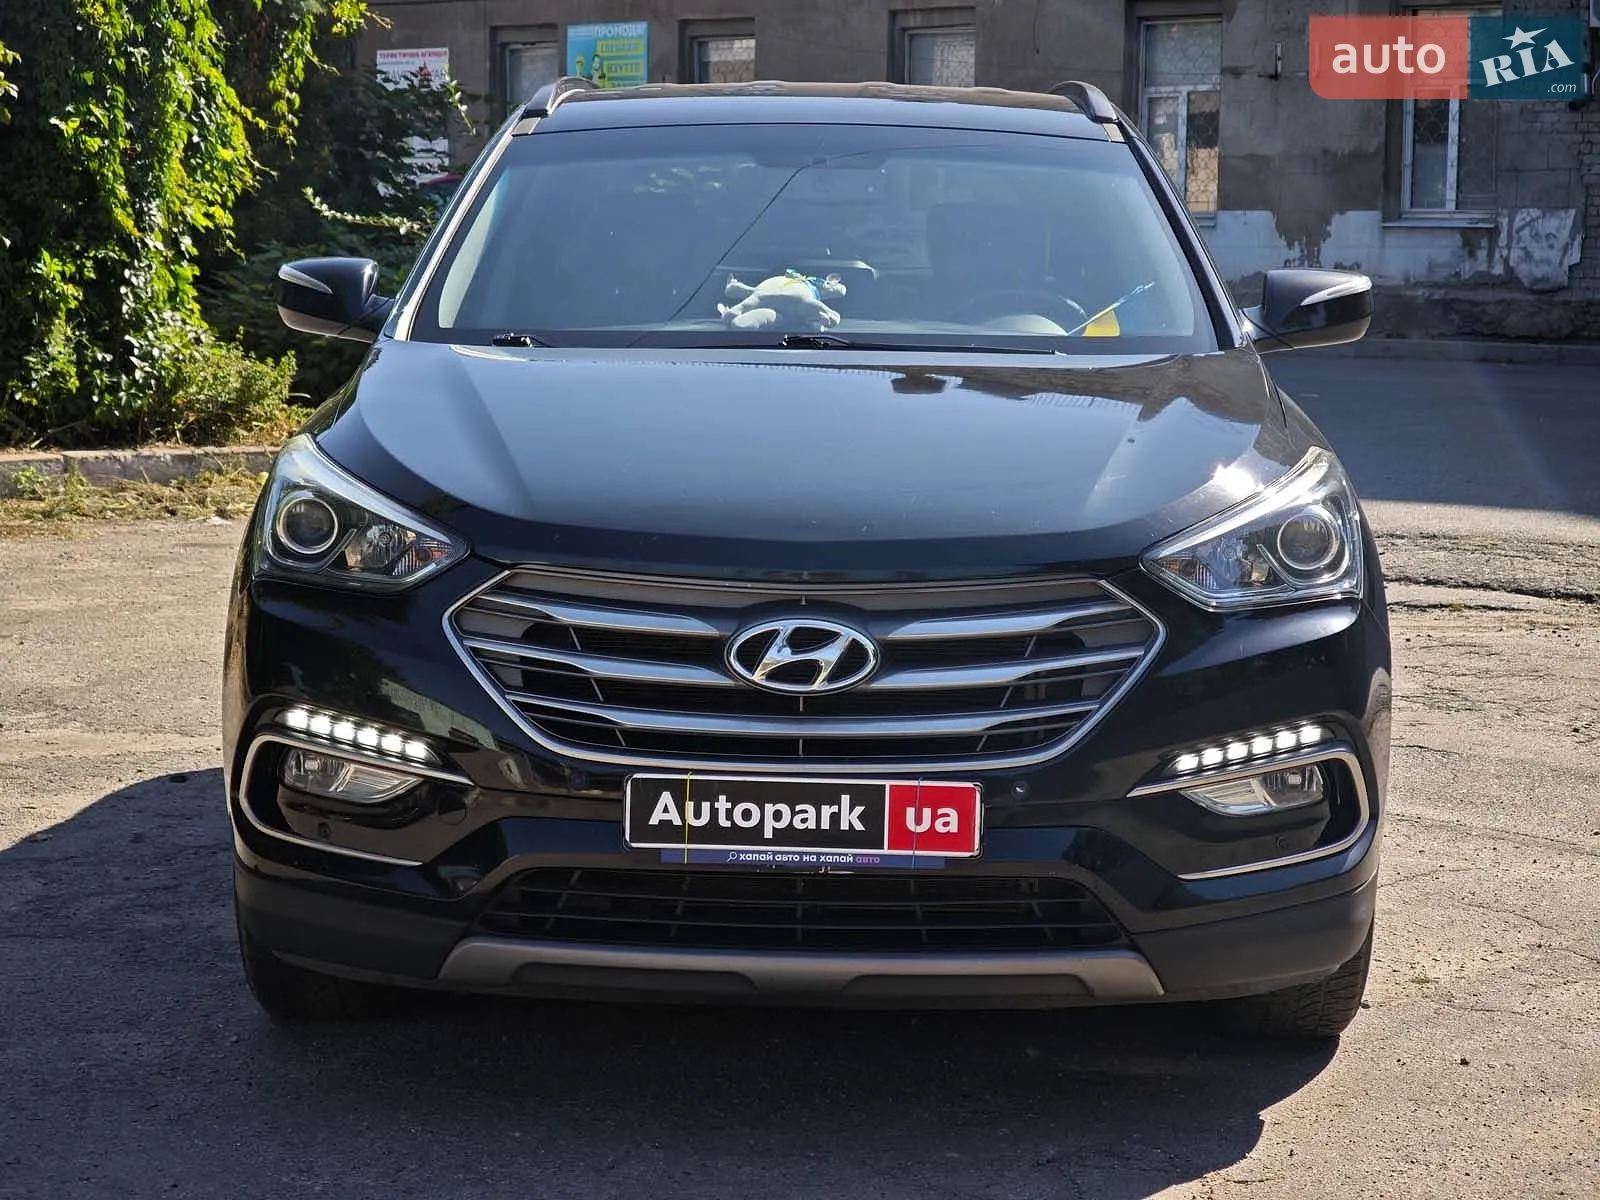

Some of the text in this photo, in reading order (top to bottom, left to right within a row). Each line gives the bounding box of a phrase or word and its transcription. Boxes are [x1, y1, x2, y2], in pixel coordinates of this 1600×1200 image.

[648, 791, 959, 838] Autopark ua
[739, 852, 881, 864] хапай авто на хапай авто
